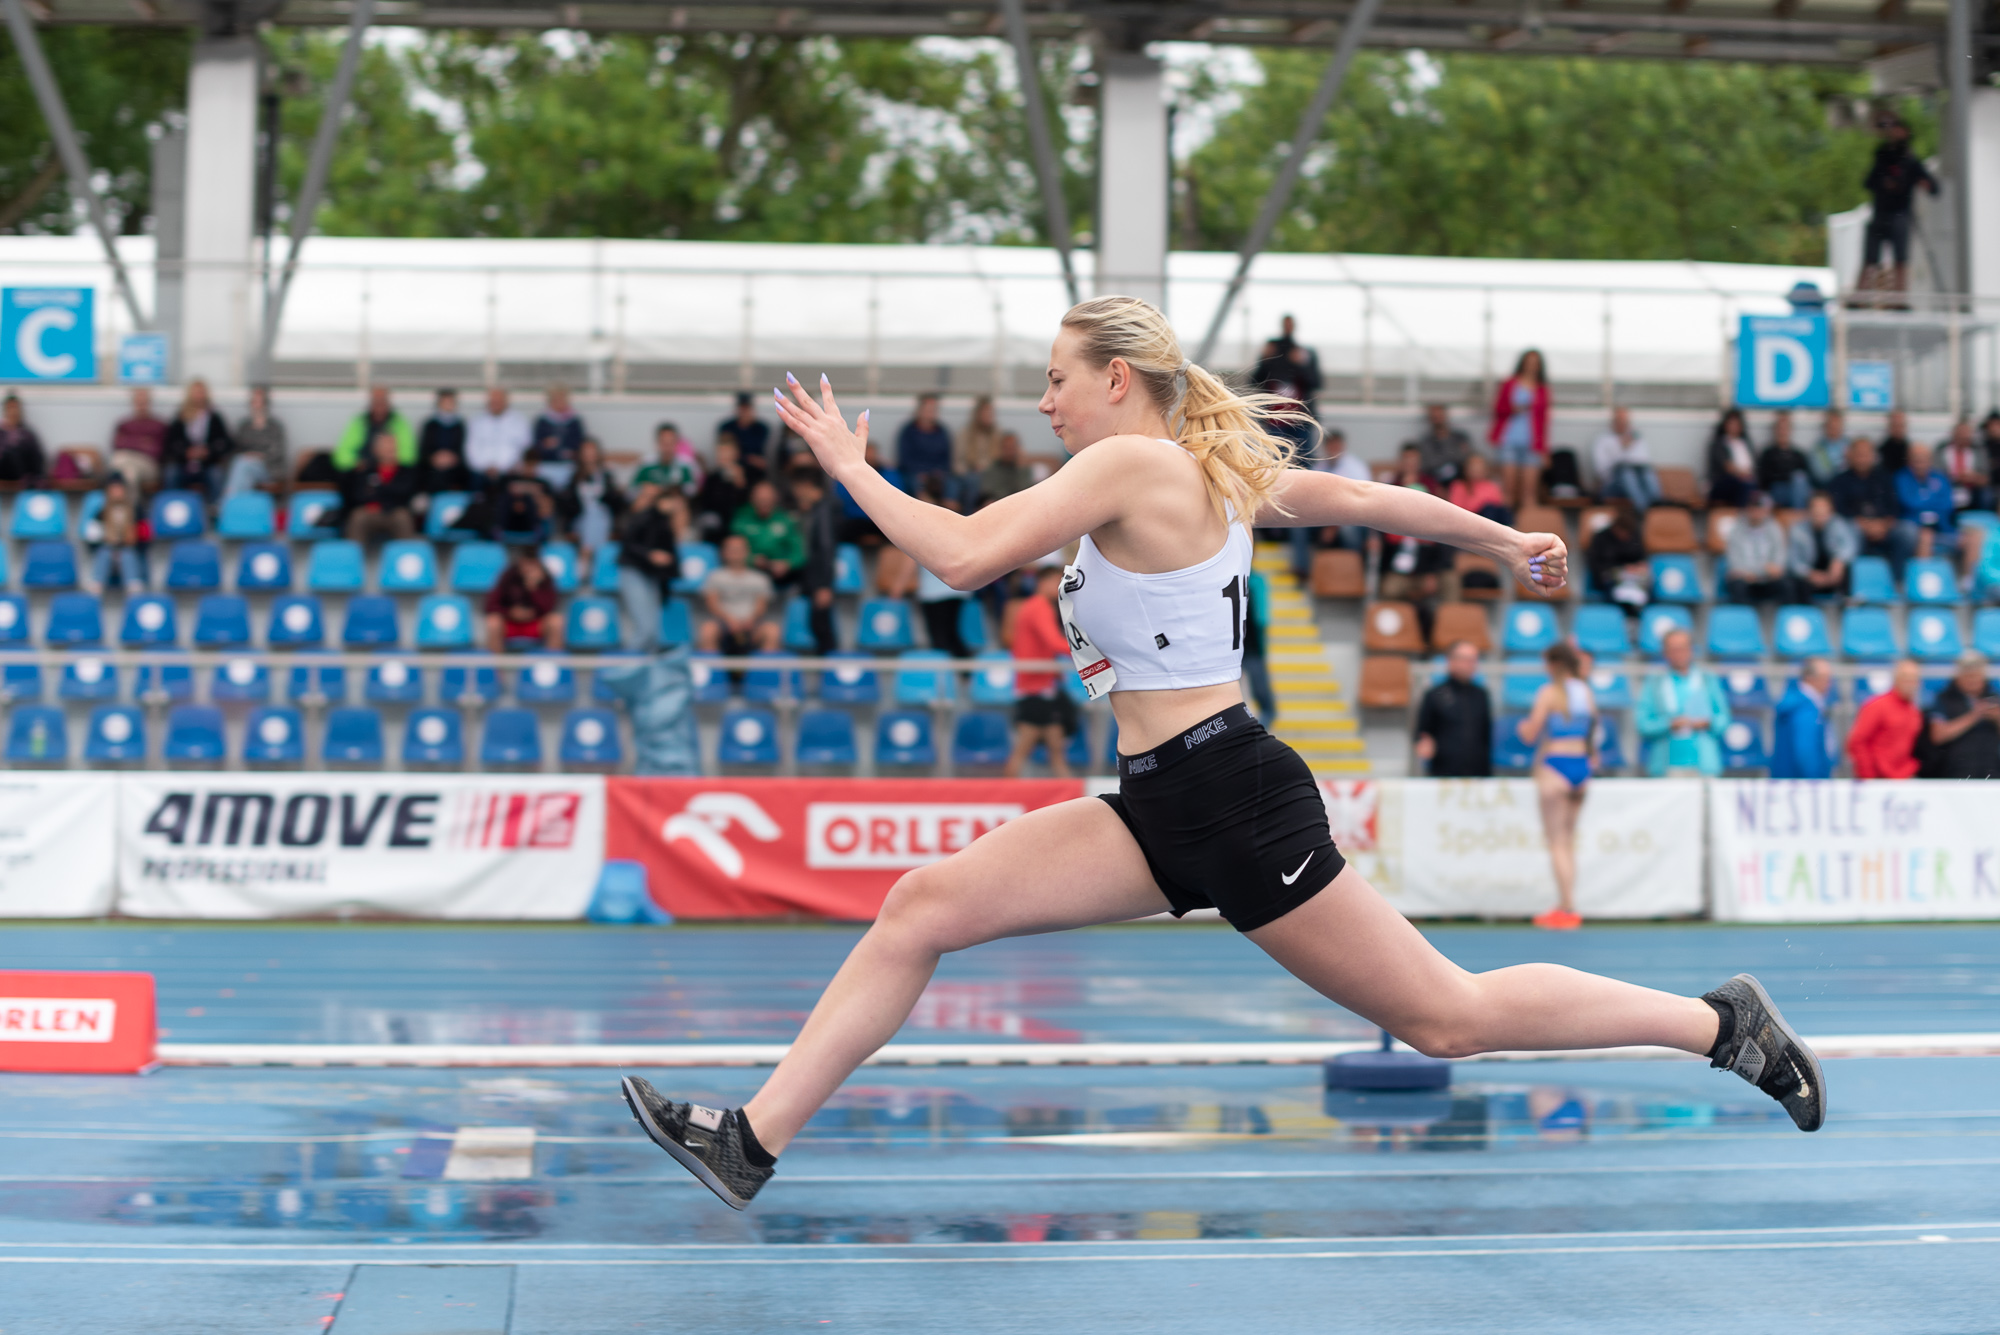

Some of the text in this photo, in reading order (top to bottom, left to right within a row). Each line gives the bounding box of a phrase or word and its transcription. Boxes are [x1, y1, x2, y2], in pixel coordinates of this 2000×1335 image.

[16, 306, 77, 378] C
[1754, 335, 1814, 402] D
[1222, 573, 1249, 651] 1
[1183, 716, 1228, 750] NIKE
[1128, 754, 1158, 775] NIKE
[143, 793, 440, 848] 4MOVE
[1738, 849, 2000, 904] HEALTHIER K
[0, 1007, 100, 1032] RLEN
